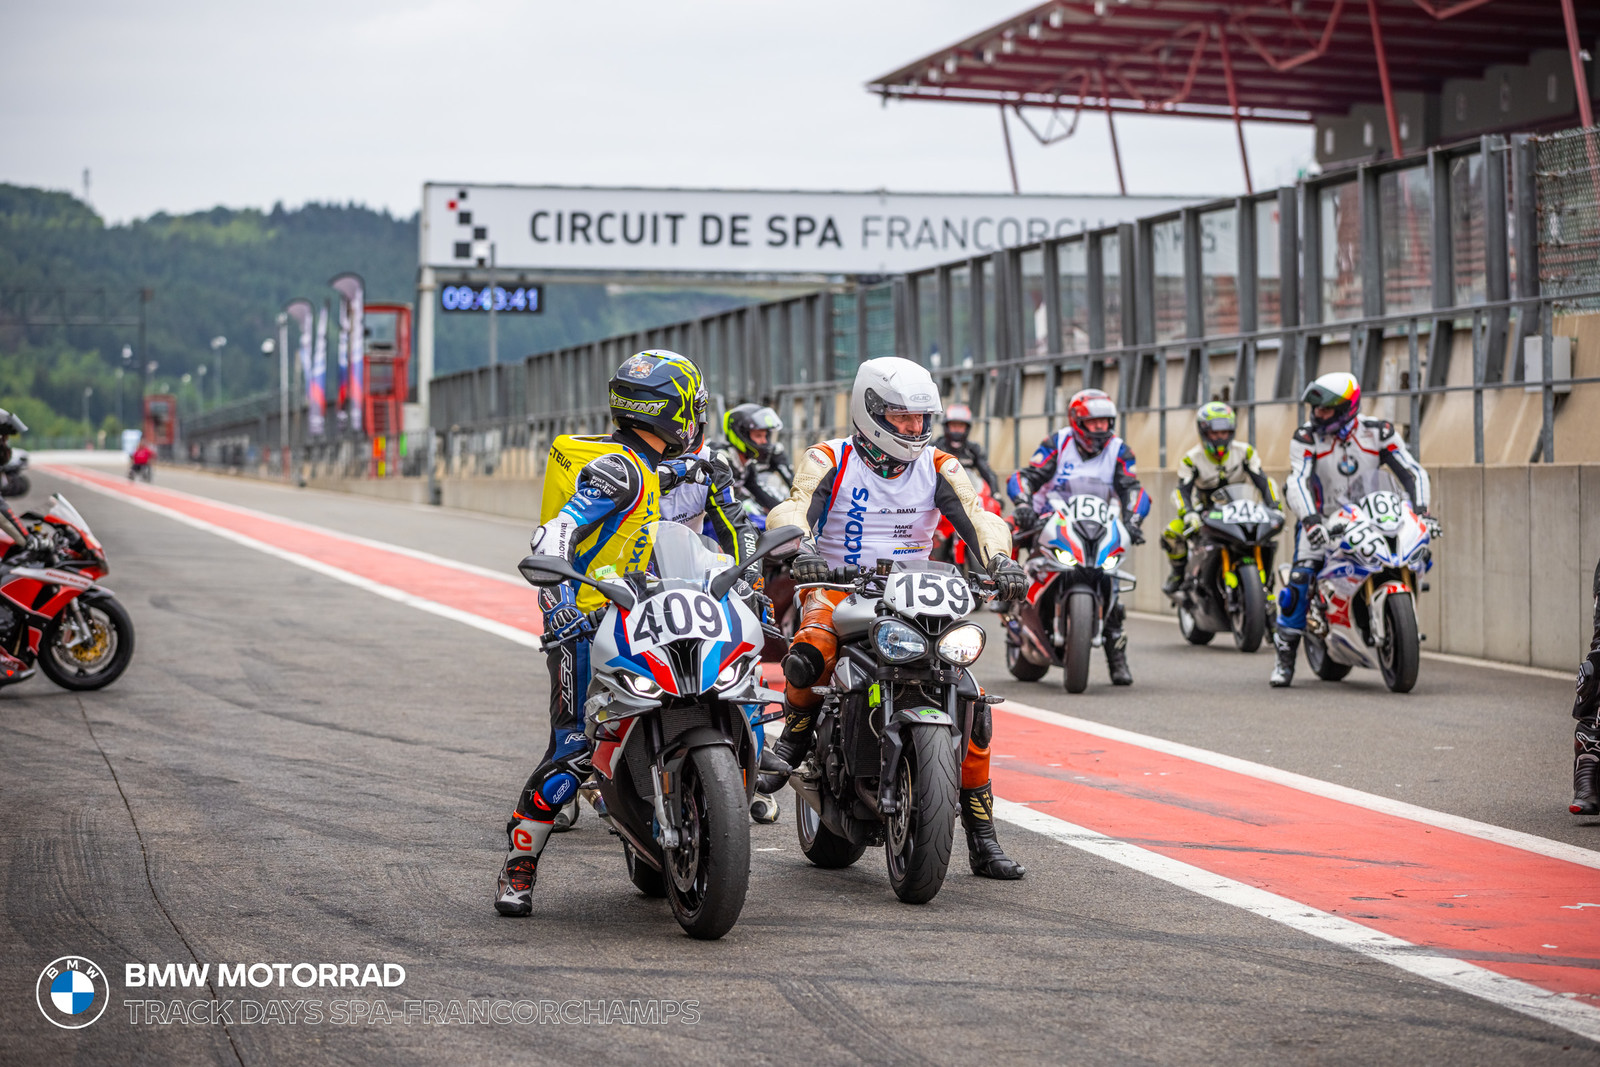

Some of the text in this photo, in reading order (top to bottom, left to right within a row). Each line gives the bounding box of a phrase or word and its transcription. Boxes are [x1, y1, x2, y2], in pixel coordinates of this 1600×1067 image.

[530, 210, 685, 244] CIRCUIT
[700, 213, 749, 246] DE
[767, 215, 841, 247] SPA
[610, 391, 666, 415] KENNY
[549, 446, 572, 471] TEUR
[895, 573, 970, 615] 159
[633, 592, 722, 645] 409
[560, 644, 574, 716] RST
